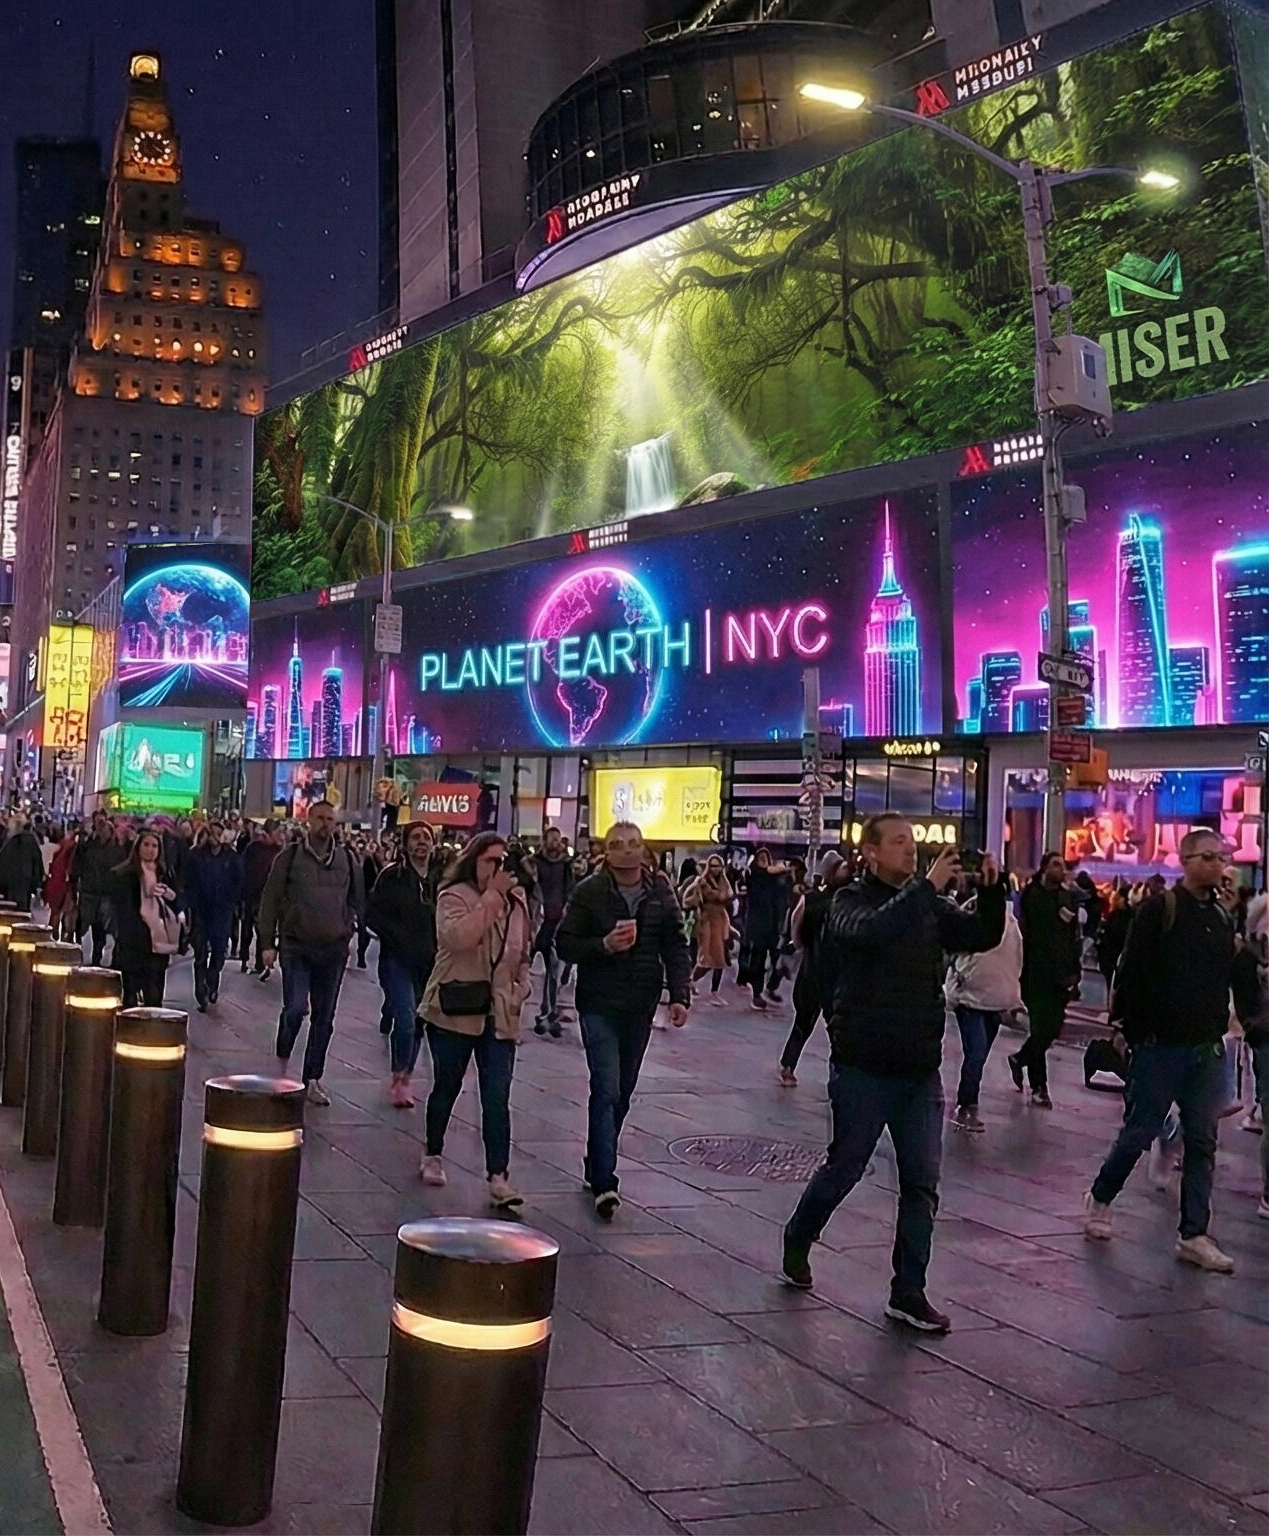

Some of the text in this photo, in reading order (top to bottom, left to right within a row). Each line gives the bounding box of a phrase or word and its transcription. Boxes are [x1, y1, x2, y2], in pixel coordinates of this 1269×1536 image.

[420, 641, 547, 692] PLANET
[558, 622, 690, 679] EARTH
[728, 604, 828, 663] NYC
